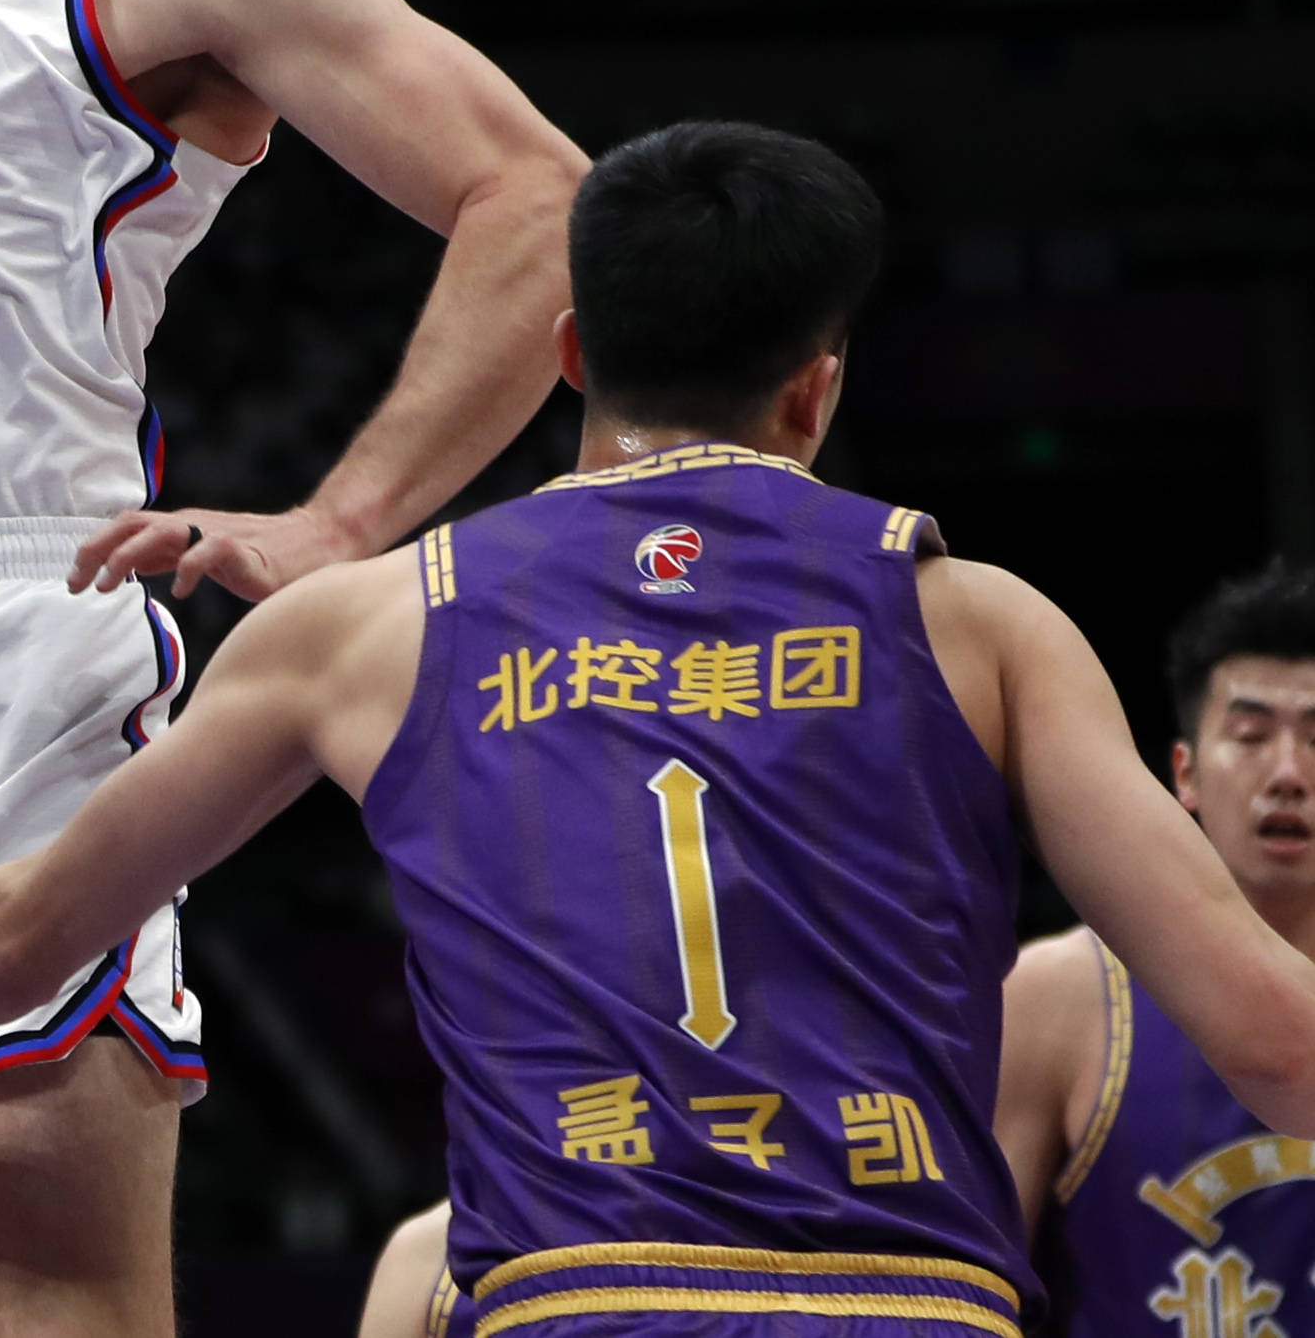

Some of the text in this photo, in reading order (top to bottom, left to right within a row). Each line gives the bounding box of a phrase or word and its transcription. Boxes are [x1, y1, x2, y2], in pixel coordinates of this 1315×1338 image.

[477, 625, 861, 733] 北控集团
[647, 758, 737, 1052] 1
[556, 1074, 945, 1186] 孟子凯
